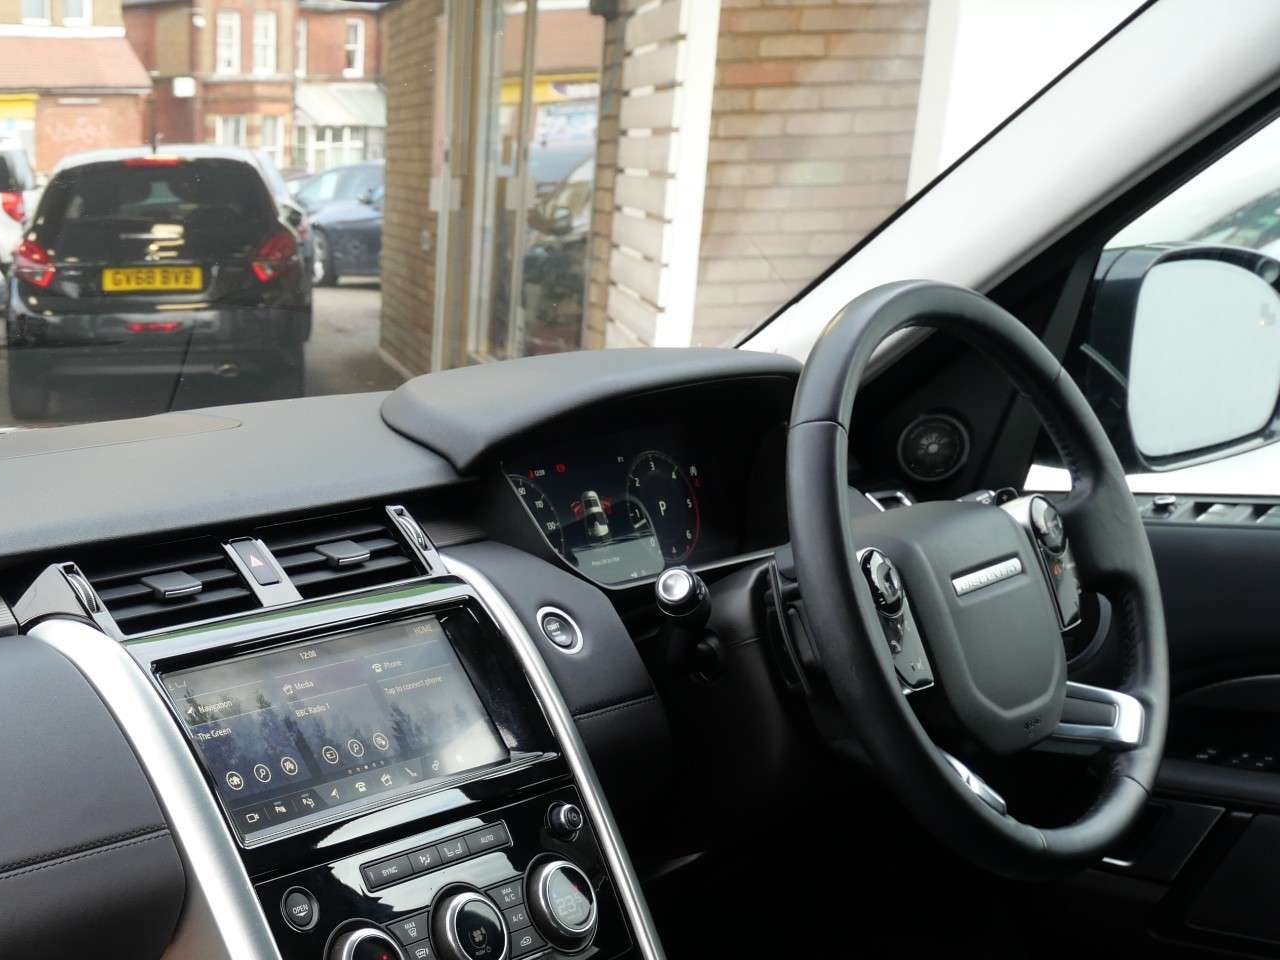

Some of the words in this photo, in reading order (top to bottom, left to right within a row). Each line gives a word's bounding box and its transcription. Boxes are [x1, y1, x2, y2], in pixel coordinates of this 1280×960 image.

[658, 500, 667, 517] P
[294, 680, 314, 690] Media
[198, 700, 233, 714] Navigation
[198, 730, 211, 741] The
[210, 727, 232, 738] Green
[292, 903, 309, 914] OPEN
